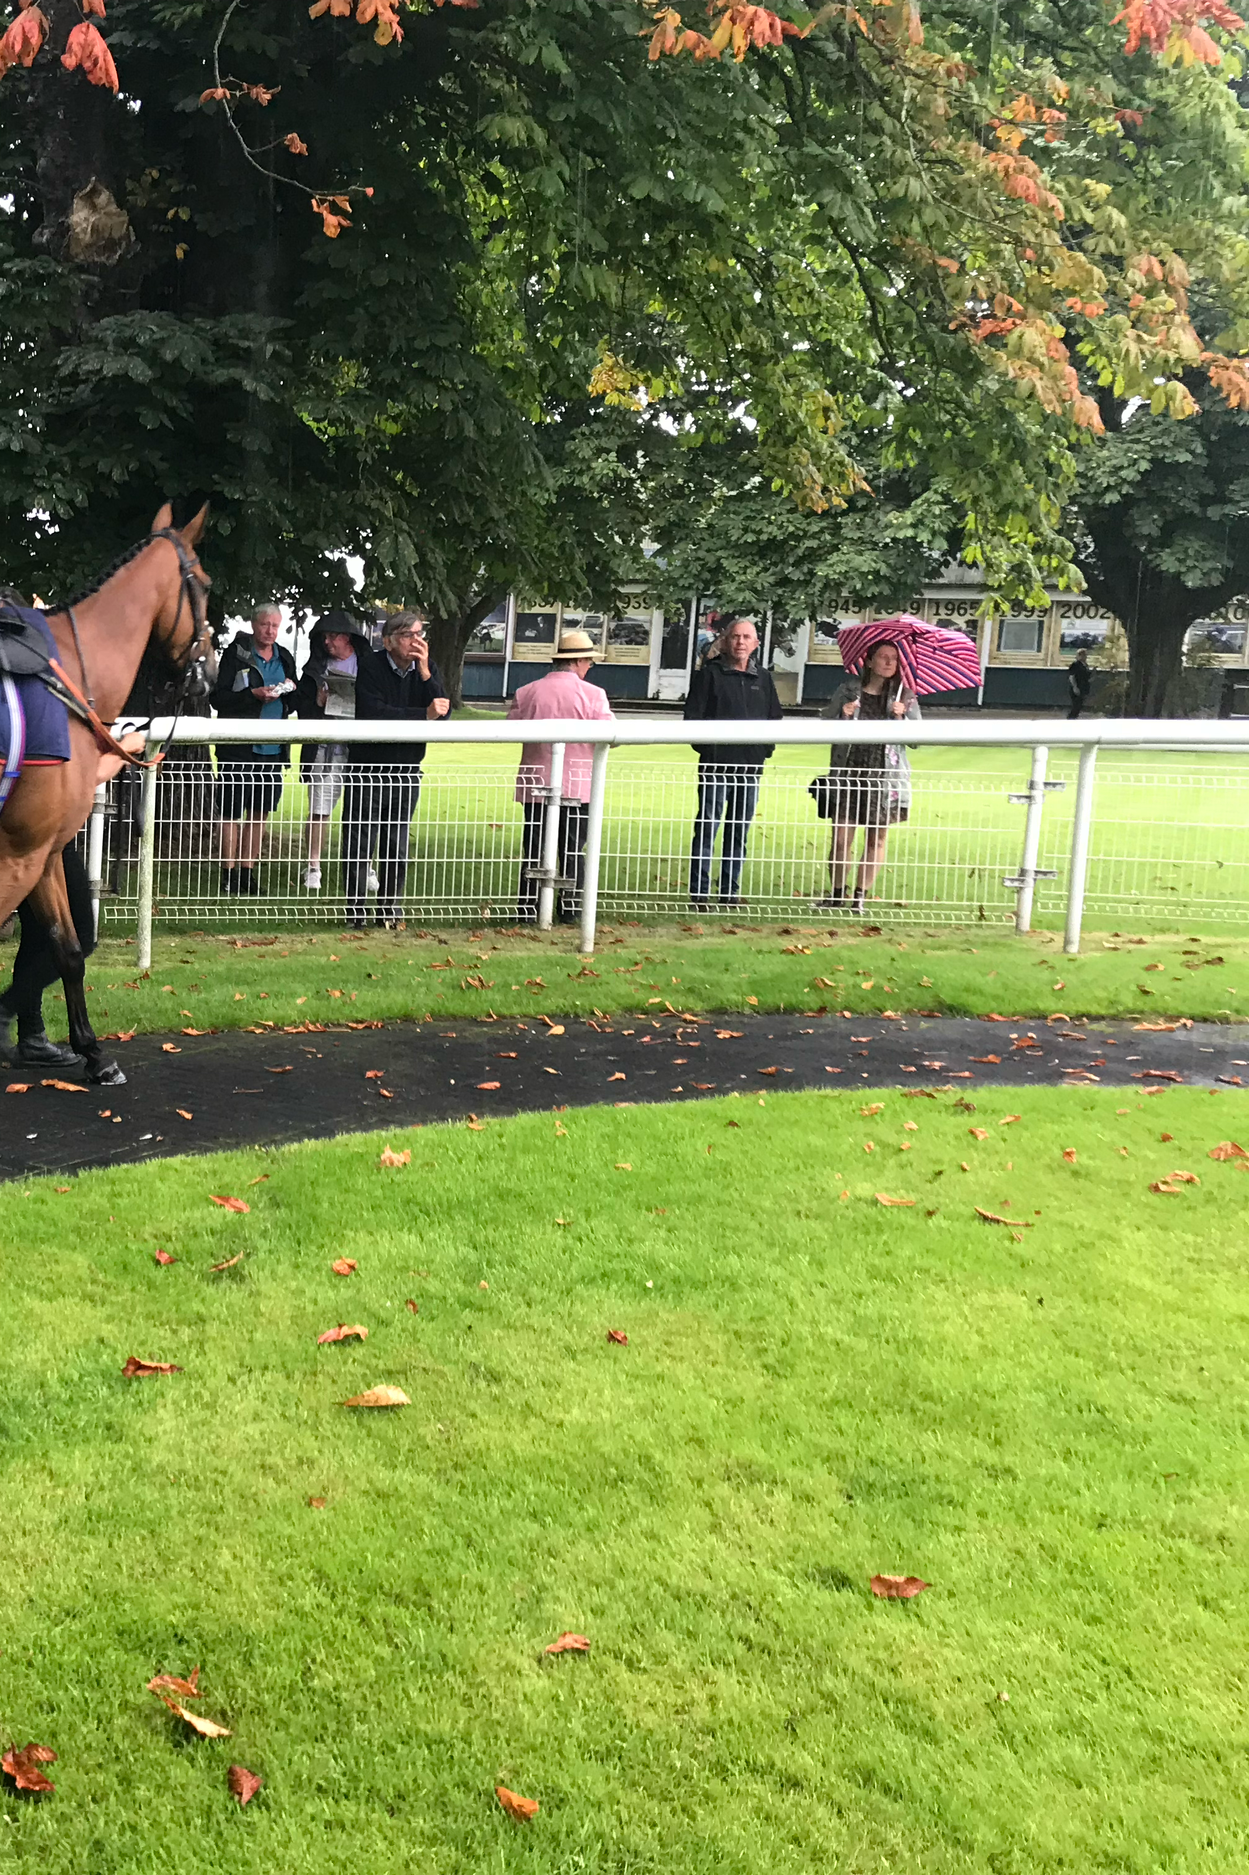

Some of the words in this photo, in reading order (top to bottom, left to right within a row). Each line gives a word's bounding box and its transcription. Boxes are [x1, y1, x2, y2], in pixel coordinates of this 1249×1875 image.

[617, 594, 653, 610] 939
[826, 598, 862, 615] 945
[933, 601, 980, 617] 1965
